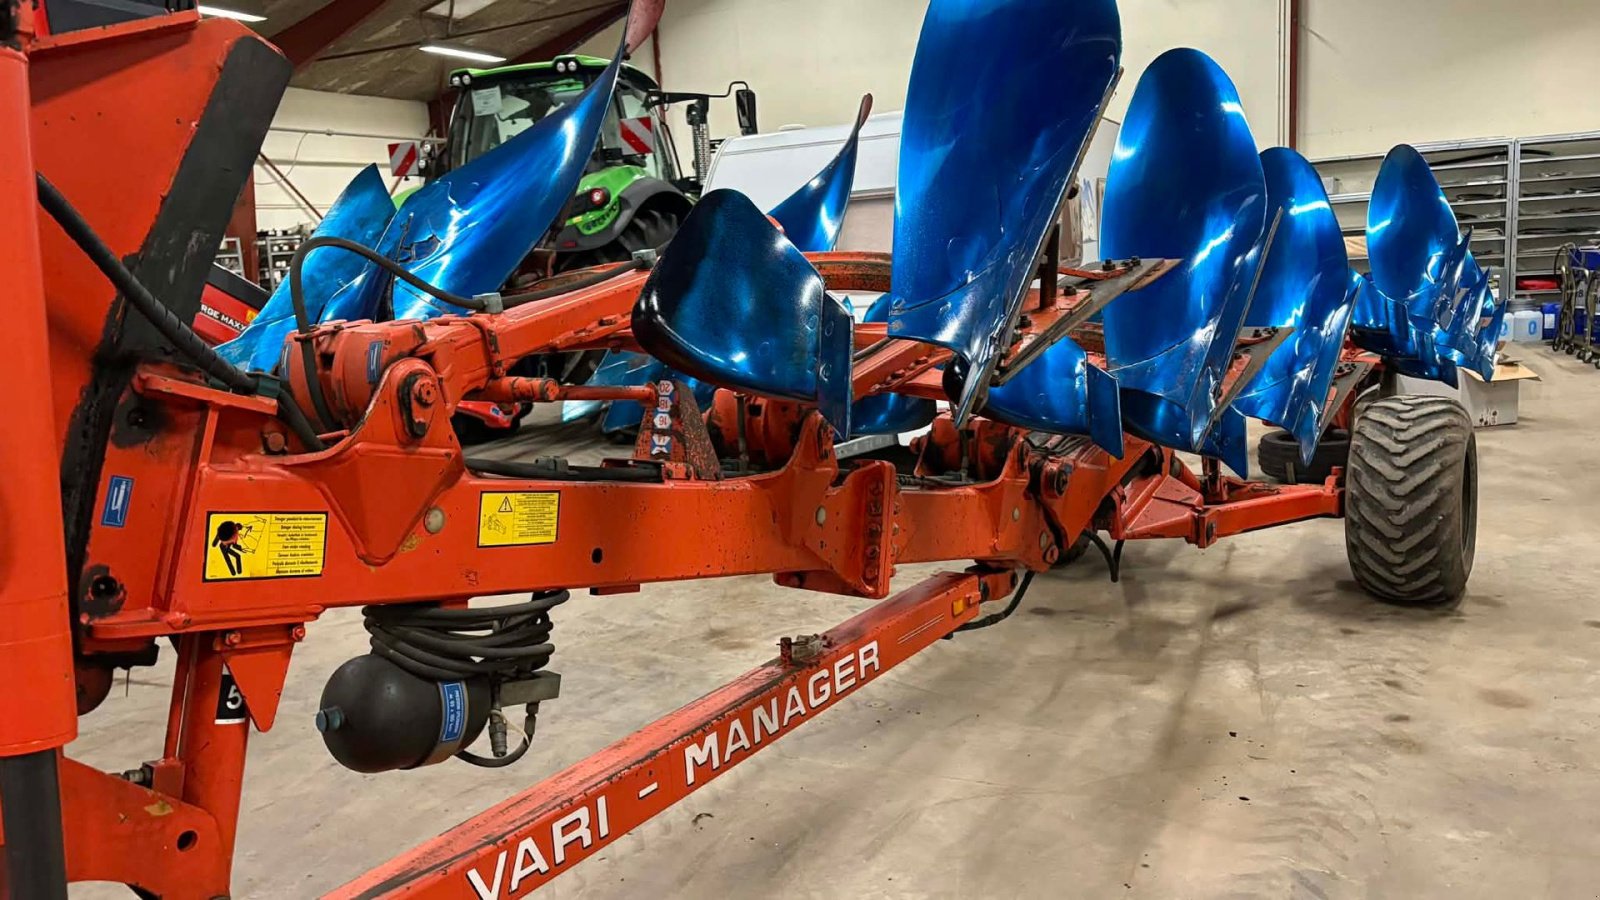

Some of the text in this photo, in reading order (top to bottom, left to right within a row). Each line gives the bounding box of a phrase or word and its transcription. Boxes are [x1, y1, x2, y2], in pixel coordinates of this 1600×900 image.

[226, 684, 243, 710] 5
[467, 795, 610, 900] VARI
[684, 640, 880, 785] MANAGER
